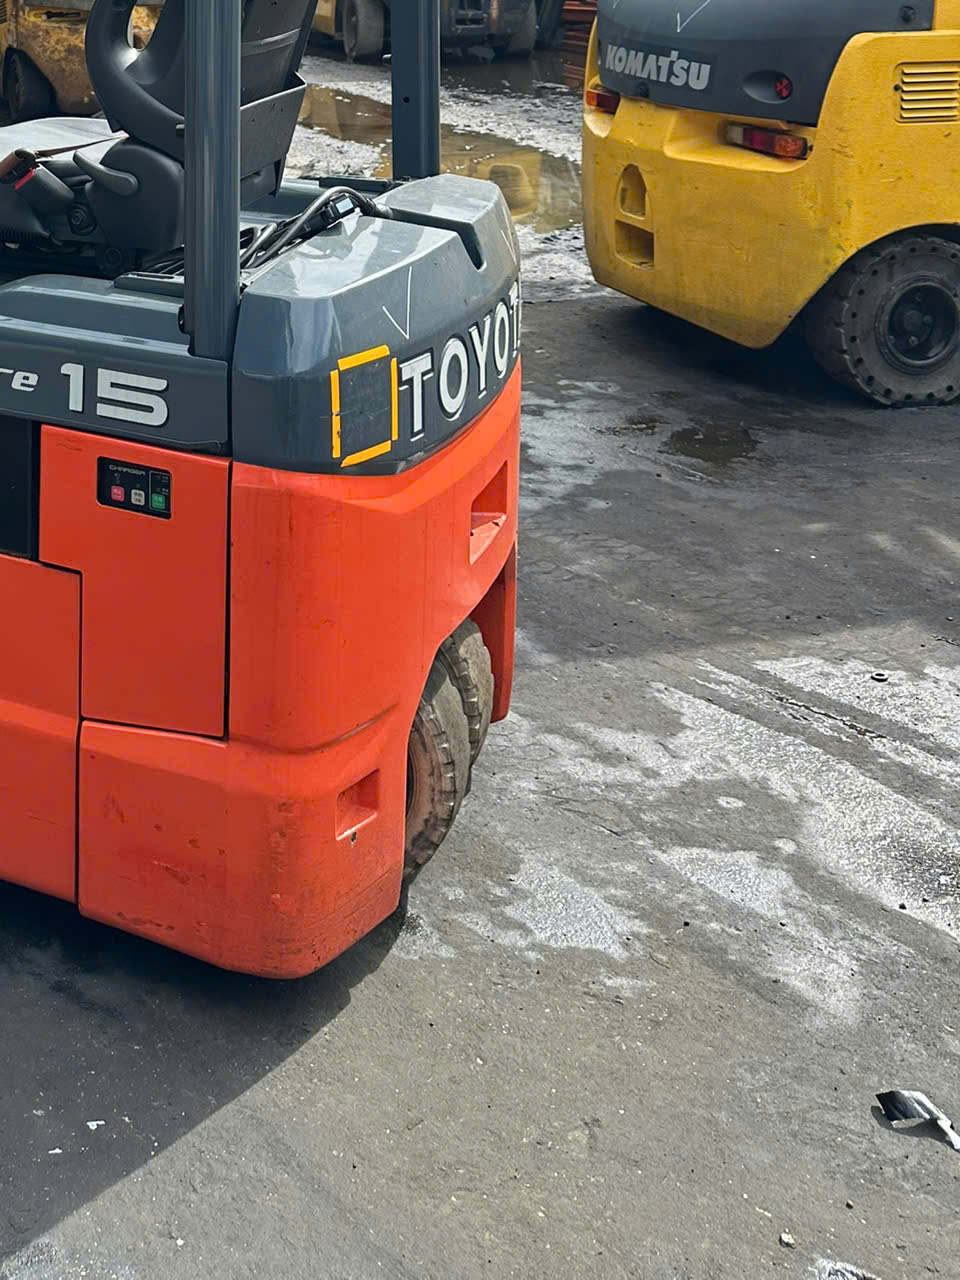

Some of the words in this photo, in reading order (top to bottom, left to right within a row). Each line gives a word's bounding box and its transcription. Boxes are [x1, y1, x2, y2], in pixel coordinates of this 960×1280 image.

[605, 44, 711, 90] KOMATSU
[399, 281, 521, 440] TOYOT
[60, 362, 169, 426] 15
